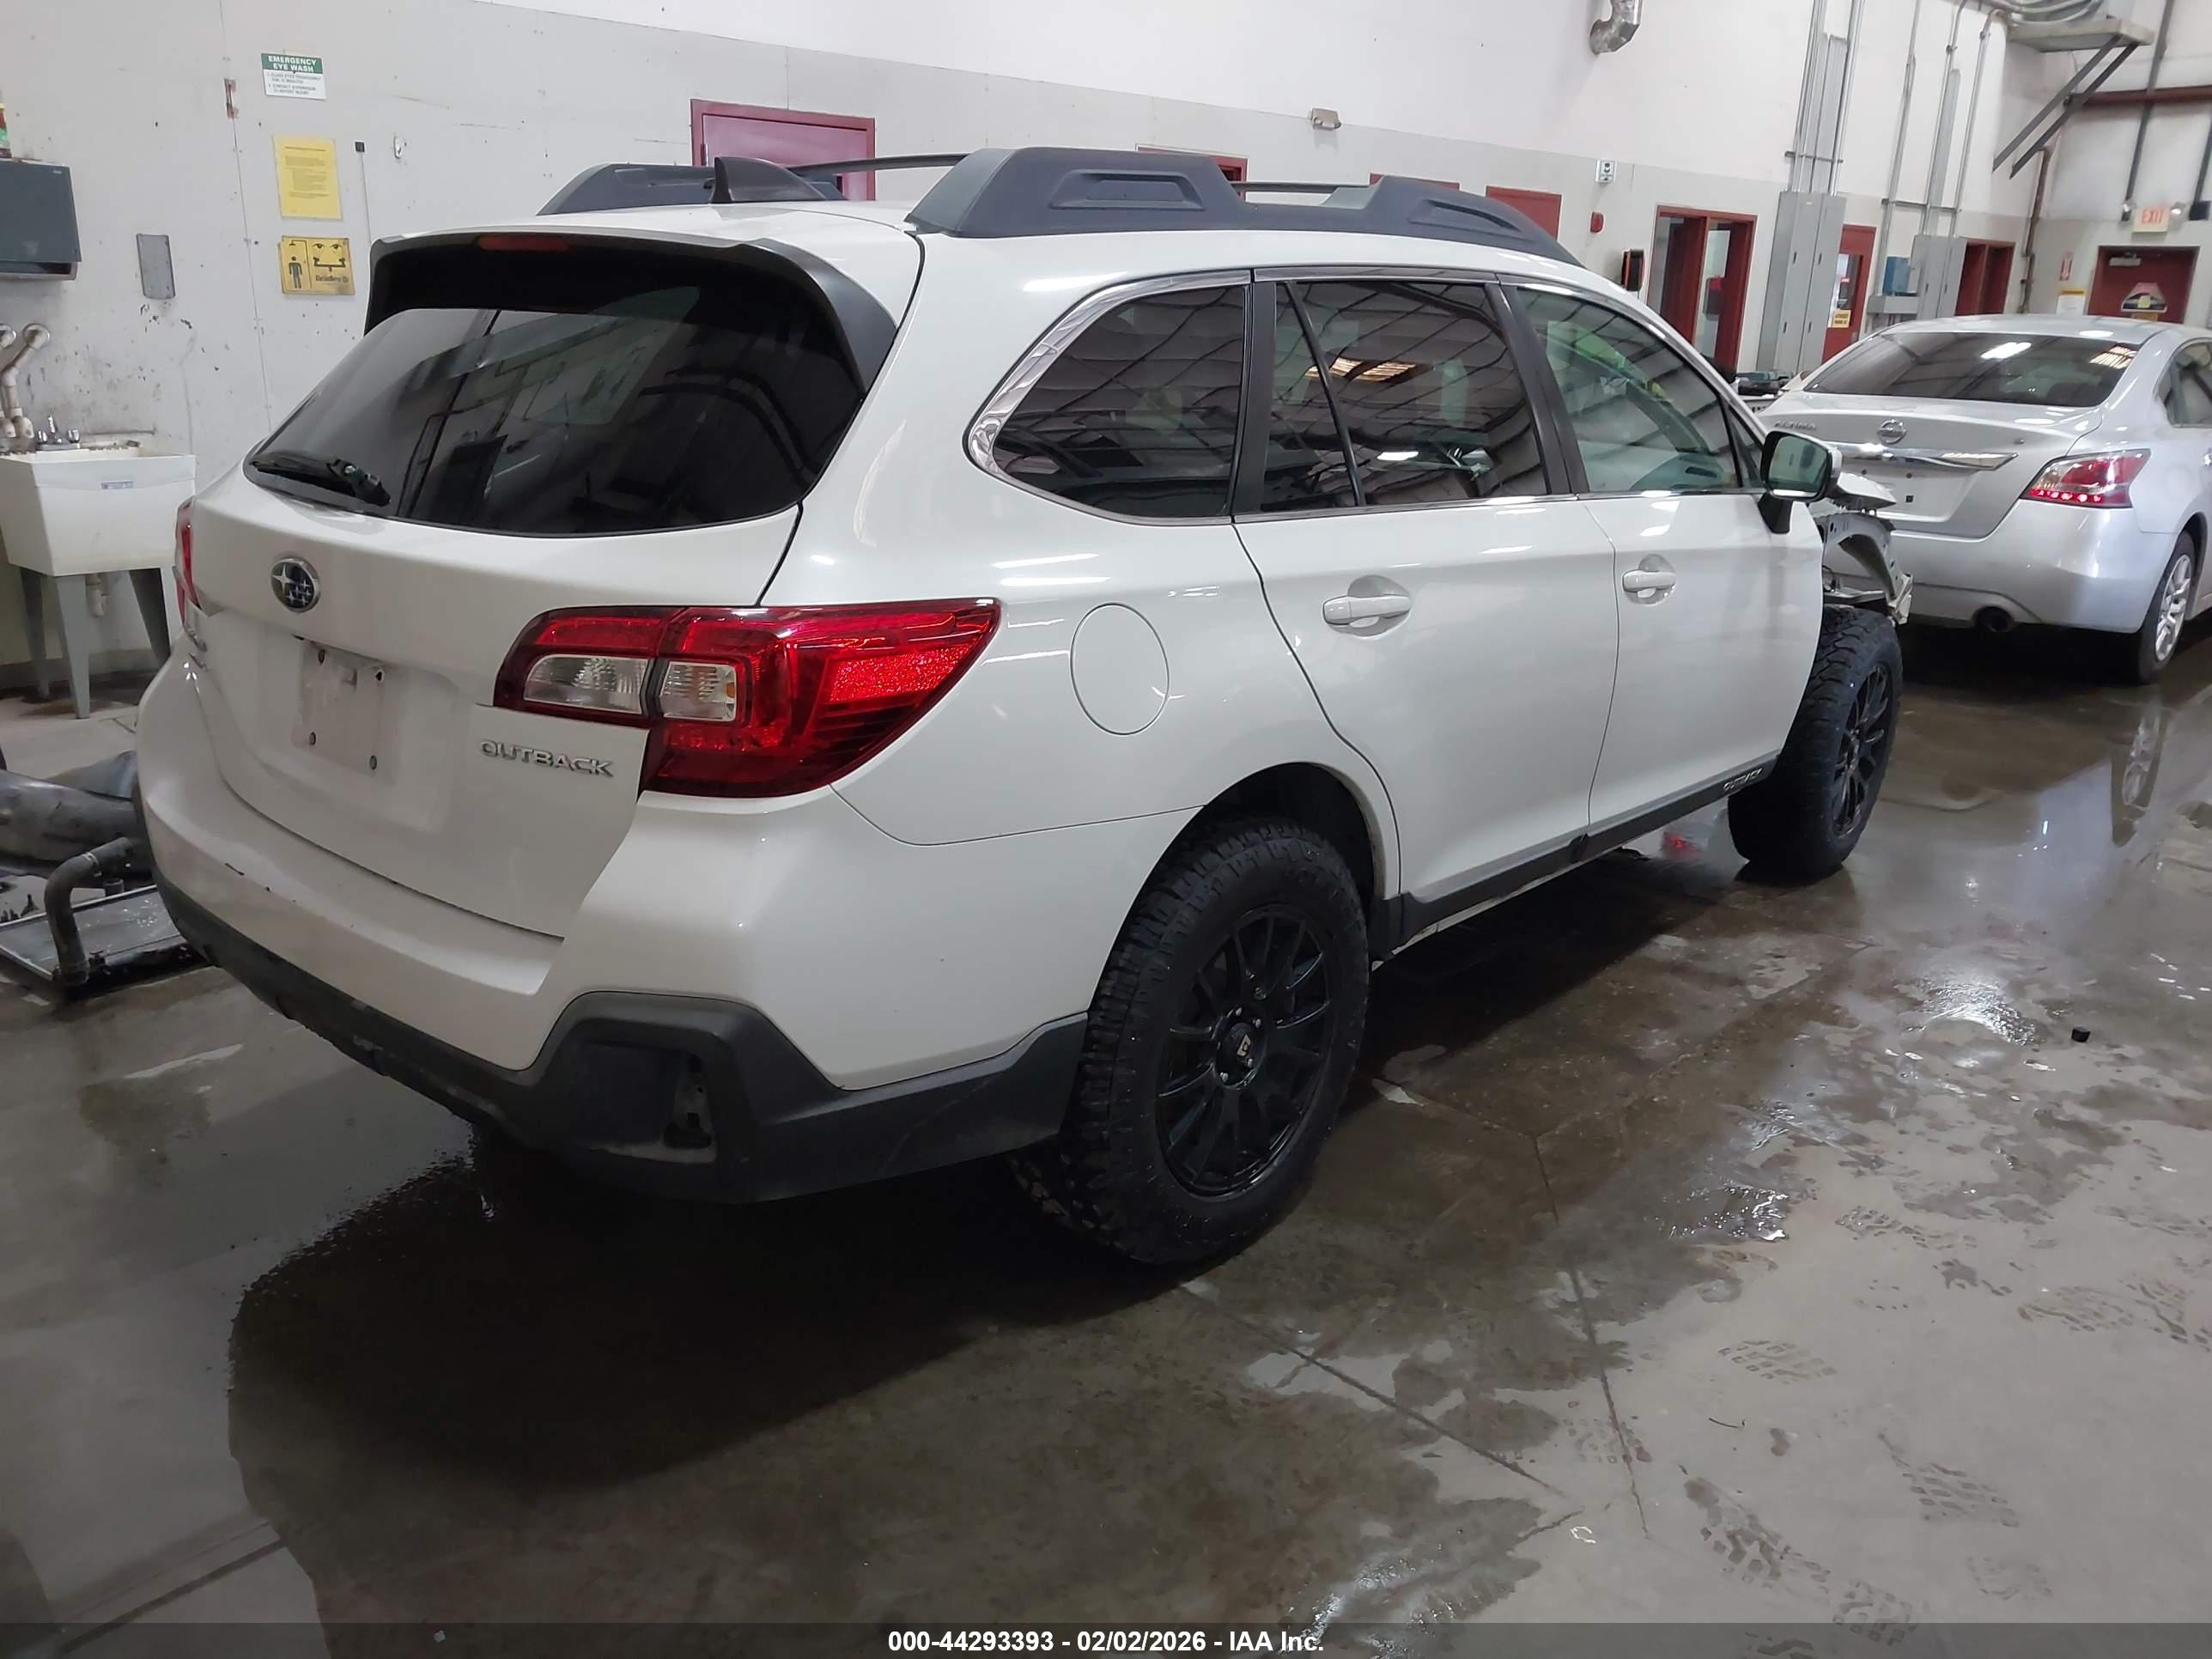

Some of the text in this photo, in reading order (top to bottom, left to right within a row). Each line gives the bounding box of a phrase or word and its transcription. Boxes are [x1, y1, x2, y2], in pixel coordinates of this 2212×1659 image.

[267, 55, 317, 66] EMERGENCY
[290, 64, 314, 73] WASH
[2142, 207, 2164, 224] EXIT
[481, 739, 614, 778] OUTBACK
